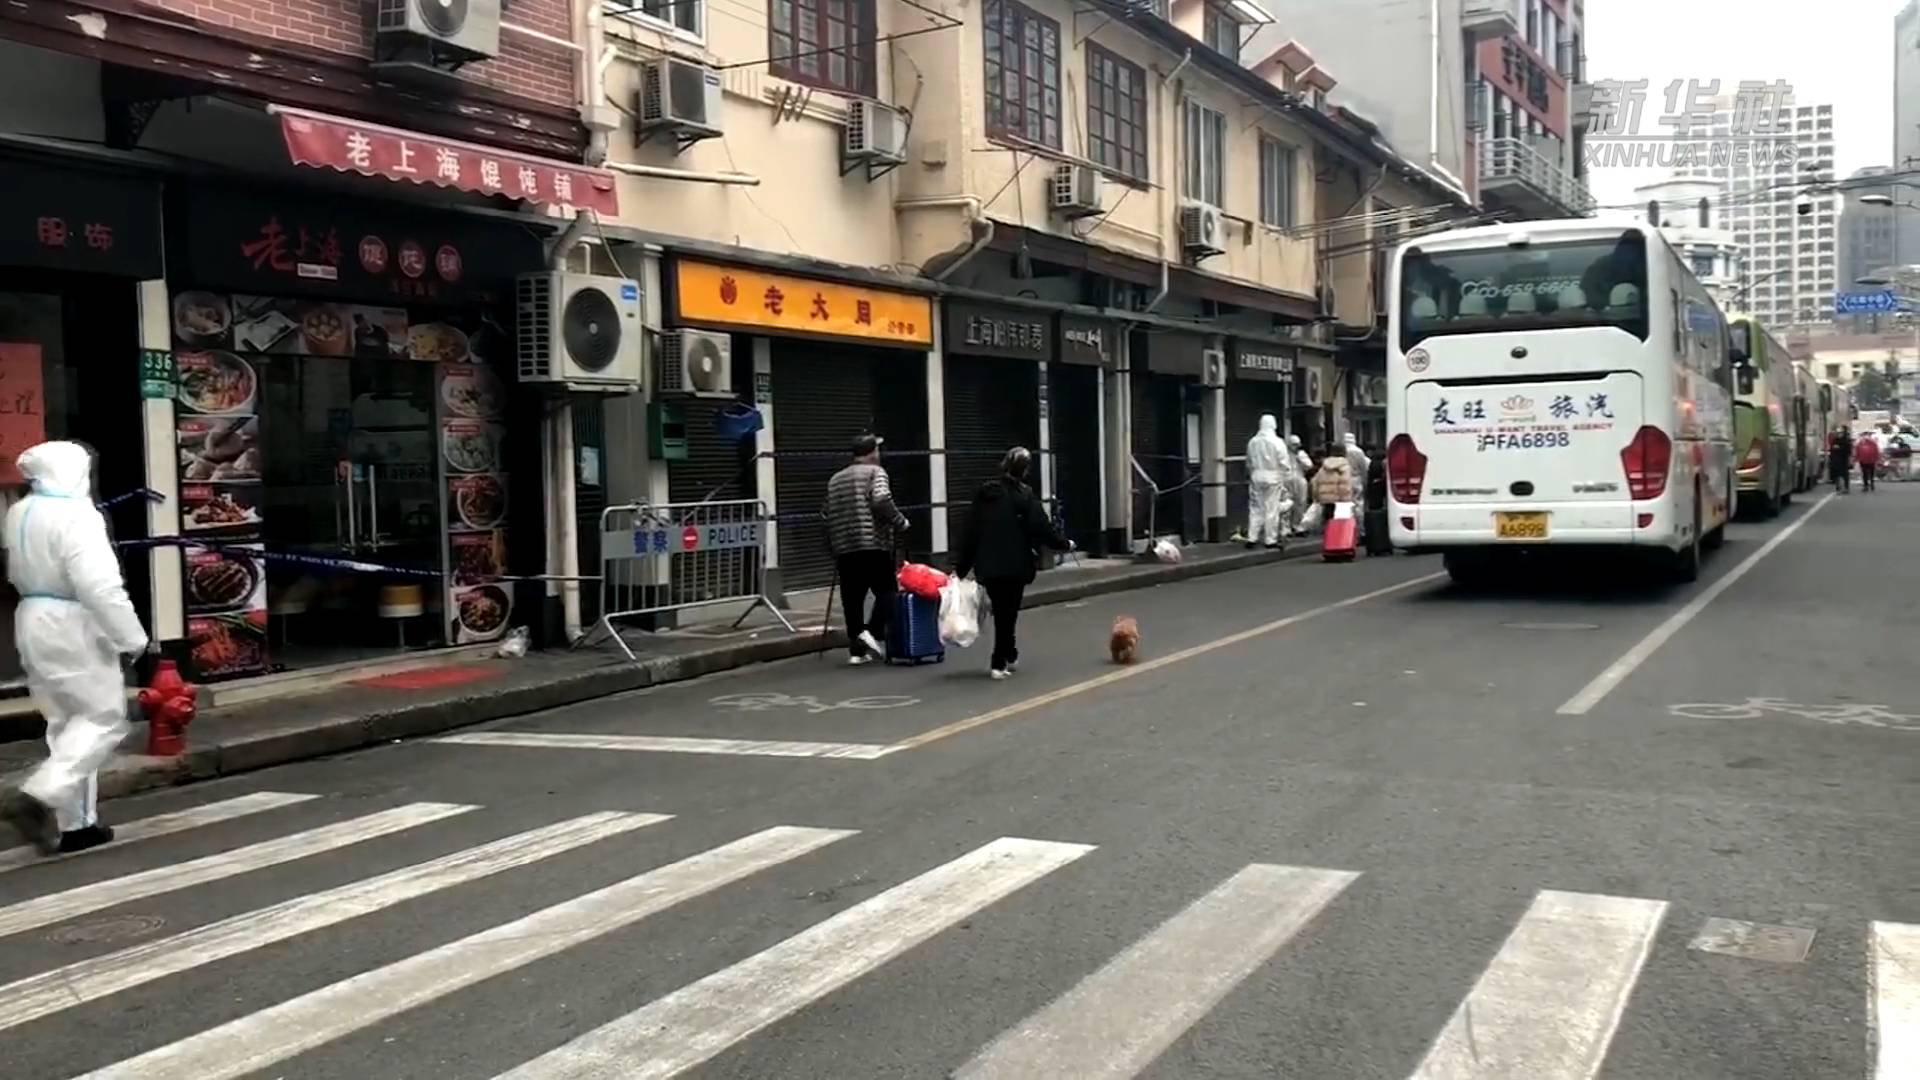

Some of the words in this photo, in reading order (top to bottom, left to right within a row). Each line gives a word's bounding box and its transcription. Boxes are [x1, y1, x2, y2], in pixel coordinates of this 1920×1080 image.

[346, 132, 572, 201] 老上海馄饨铺
[37, 216, 114, 250] 服饰
[144, 352, 172, 370] 336
[1433, 398, 1487, 426] 友旺
[1549, 393, 1615, 419] 旅汽
[1477, 431, 1570, 452] 沪FA6898
[708, 524, 757, 547] POLICE
